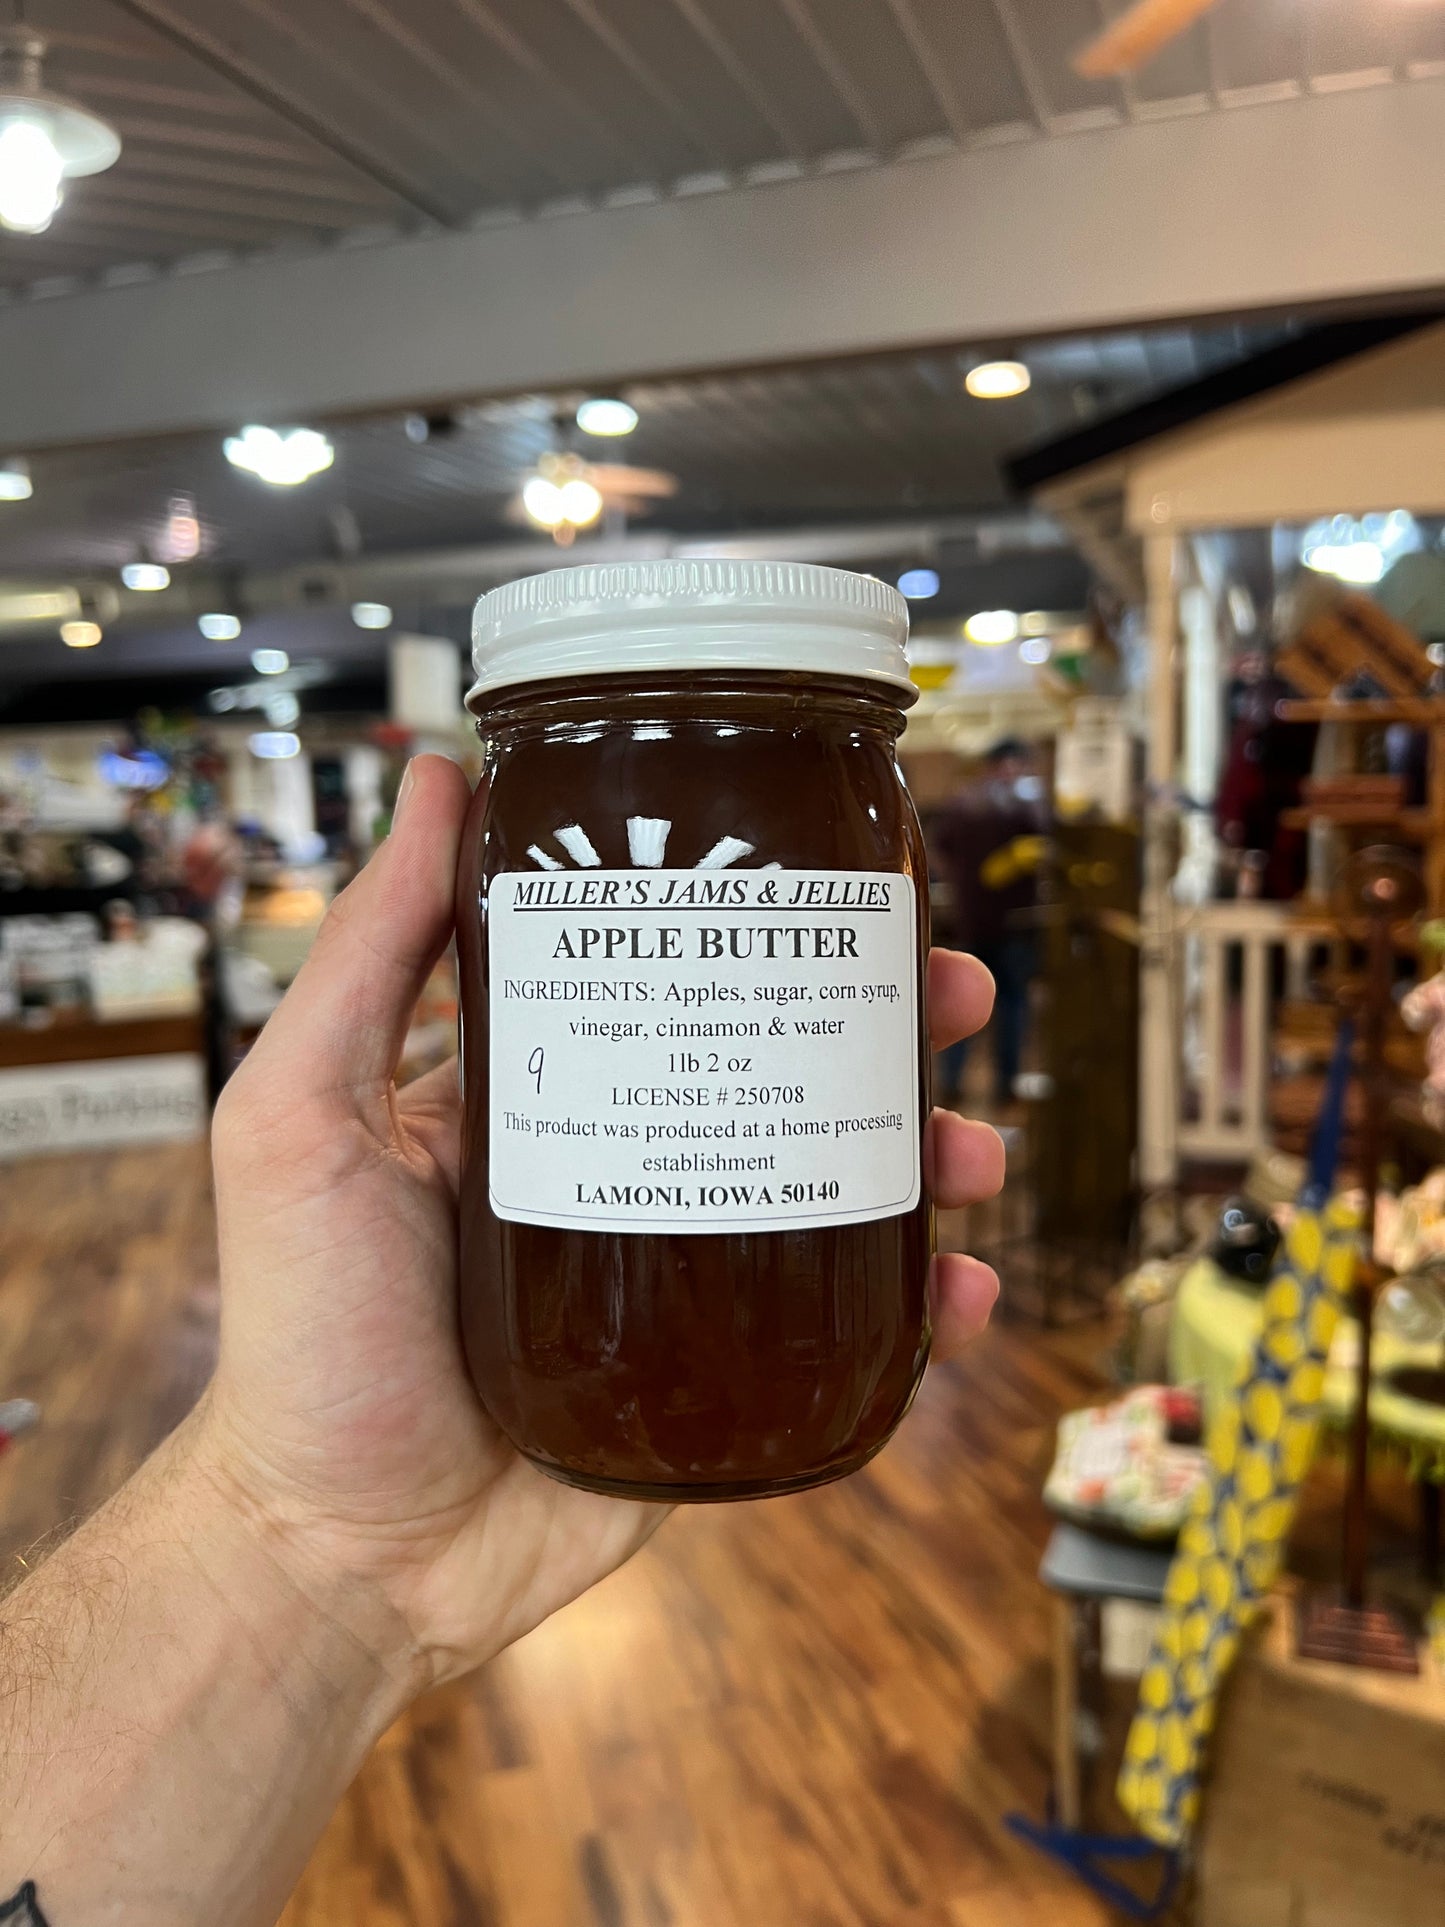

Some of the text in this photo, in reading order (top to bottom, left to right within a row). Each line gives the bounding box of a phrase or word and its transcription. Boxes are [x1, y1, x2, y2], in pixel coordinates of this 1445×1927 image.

[658, 879, 749, 905] JAMS
[756, 879, 779, 905] &
[787, 880, 891, 907] JELLIES
[551, 927, 860, 959] APPLE BUTTER
[504, 979, 901, 1008] INGREDIENTS: Apples, sugar, corn syrup,
[569, 1015, 846, 1043] vinegar, cinnamon & water
[707, 1052, 720, 1073] 2
[727, 1057, 753, 1073] oz
[612, 1085, 805, 1107] LICENSE # 250708
[503, 1109, 903, 1143] This product was produced at a home processing
[642, 1152, 776, 1172] establishment
[576, 1180, 840, 1210] LAMONI, IOWA 50140
